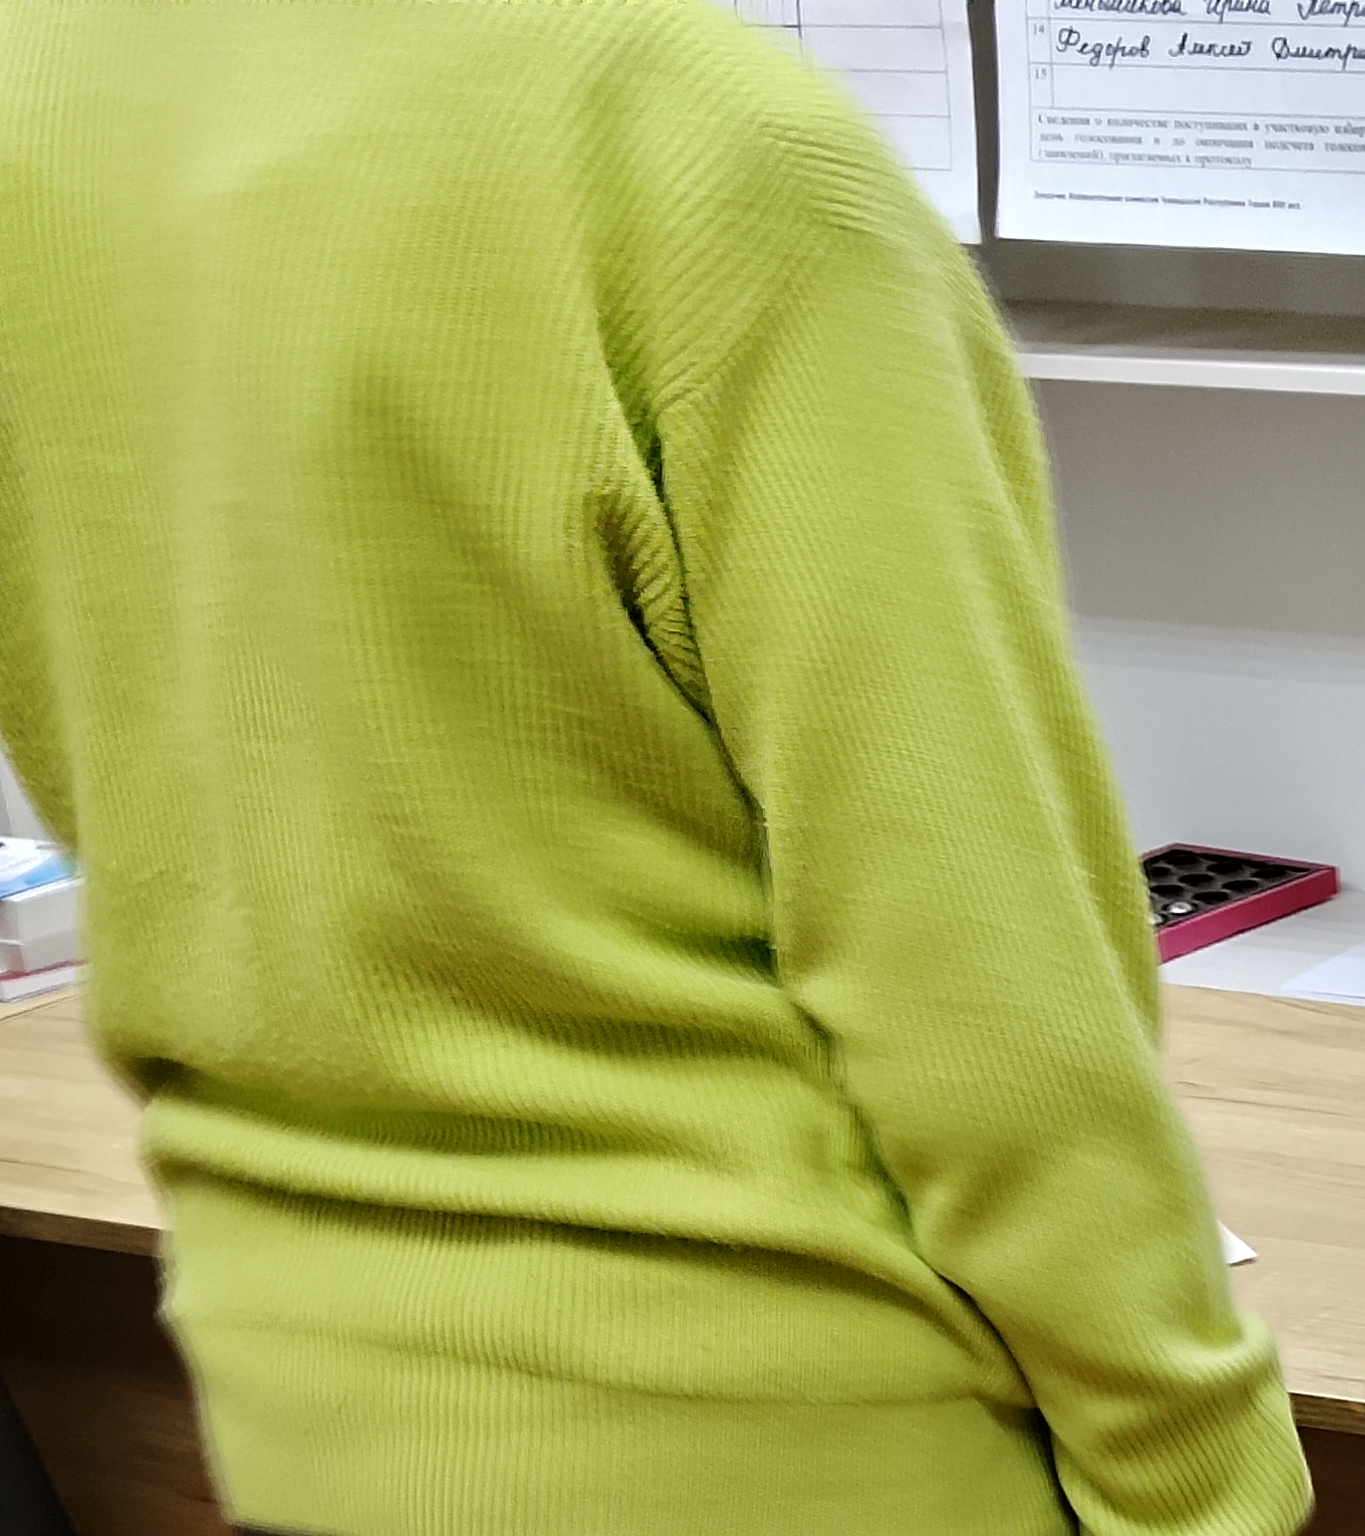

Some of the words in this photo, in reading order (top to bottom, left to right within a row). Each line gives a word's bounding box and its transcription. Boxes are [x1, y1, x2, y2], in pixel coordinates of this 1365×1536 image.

[1032, 25, 1046, 36] 14
[1057, 25, 1152, 69] Федоров
[1035, 69, 1048, 80] 15
